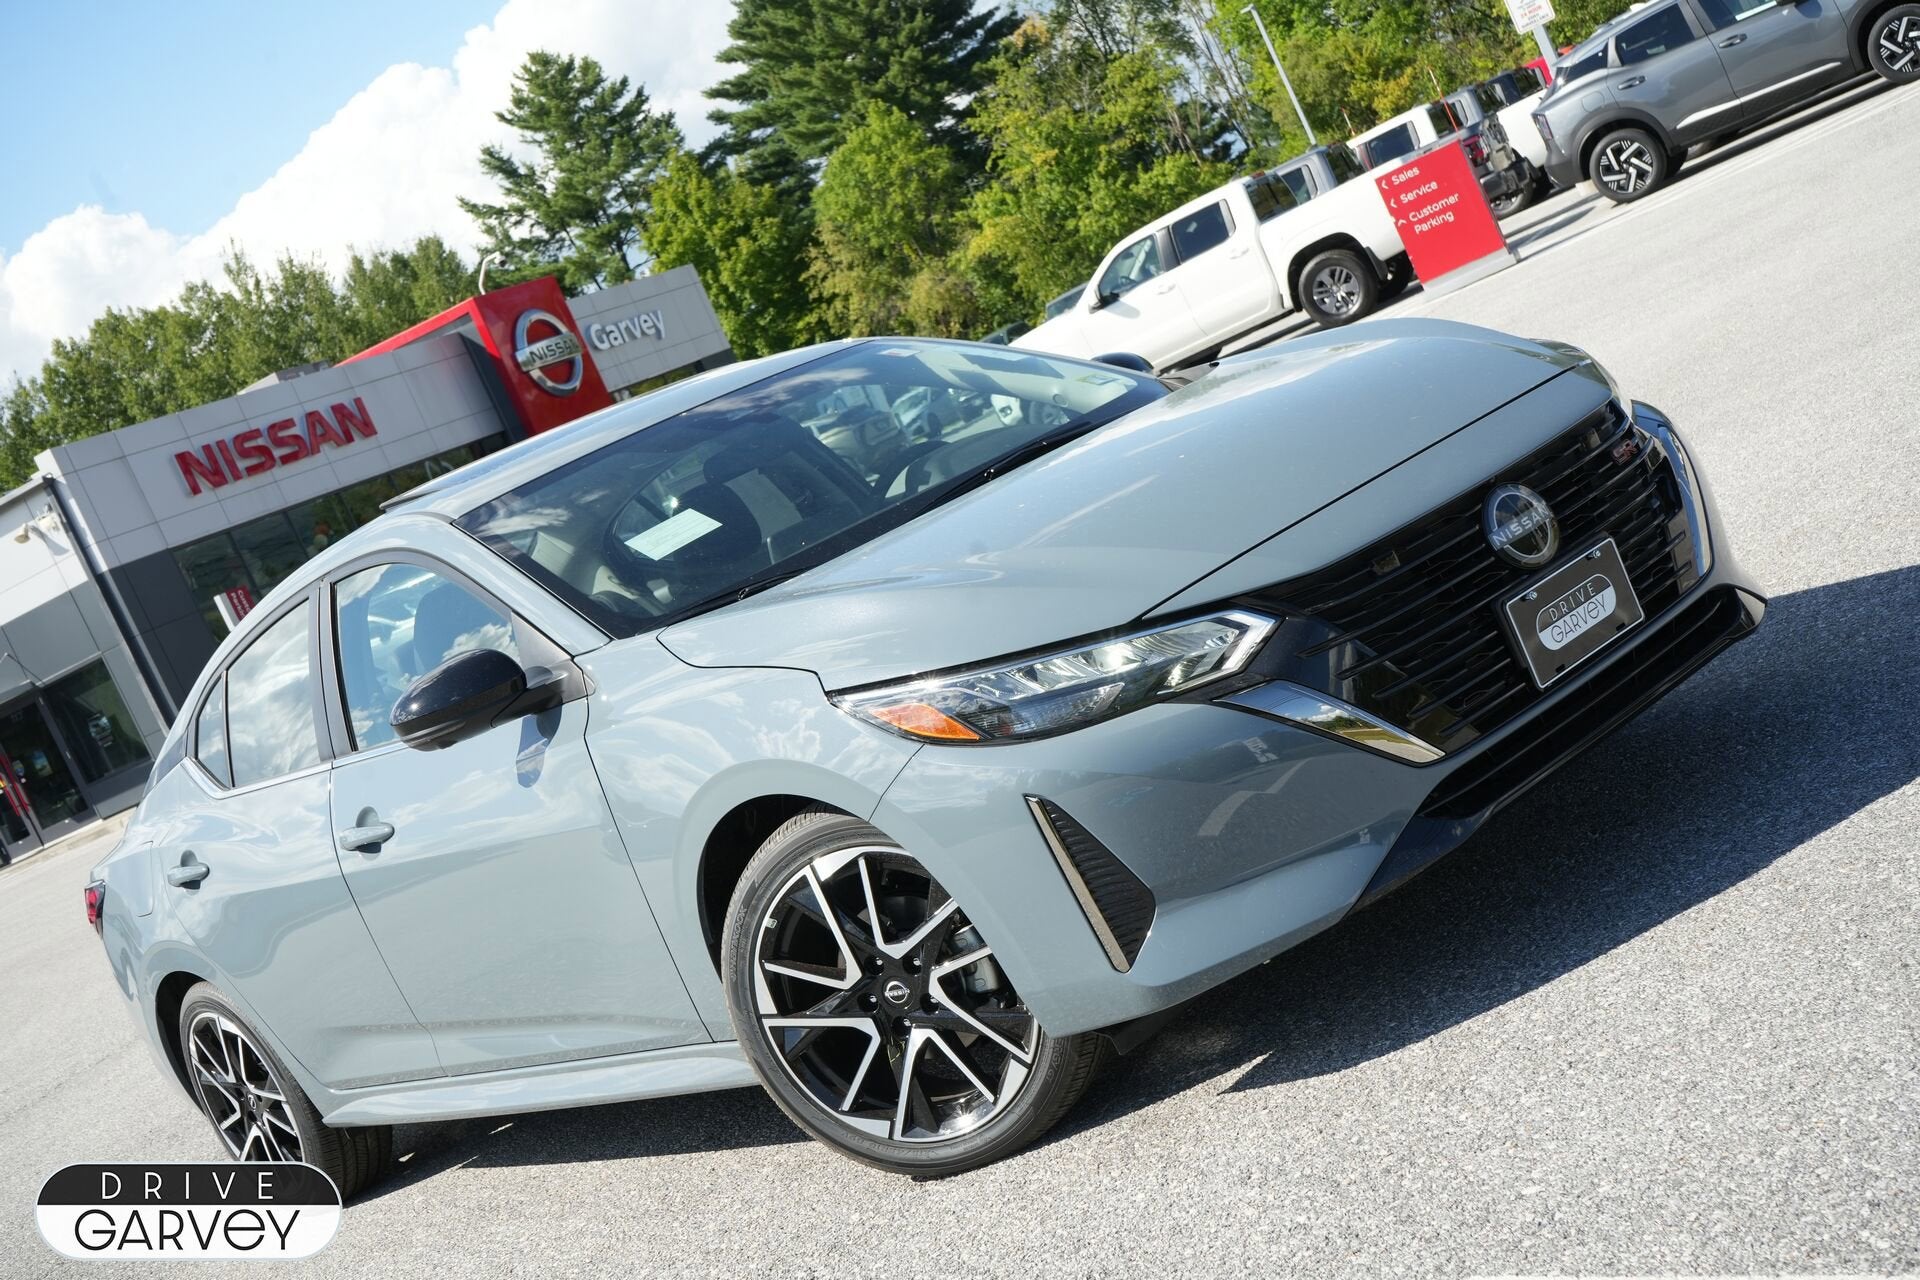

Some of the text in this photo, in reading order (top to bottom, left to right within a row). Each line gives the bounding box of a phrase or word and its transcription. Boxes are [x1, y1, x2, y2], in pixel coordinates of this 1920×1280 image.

[1391, 166, 1420, 186] Sales
[1399, 181, 1439, 204] Service
[1408, 193, 1459, 222] Customer
[1413, 211, 1455, 235] Parking
[588, 310, 666, 351] Garvey
[528, 338, 580, 364] NISSAN
[174, 397, 378, 496] NISSAN
[1492, 504, 1551, 546] NISSAN
[1549, 582, 1597, 621] DRIVE
